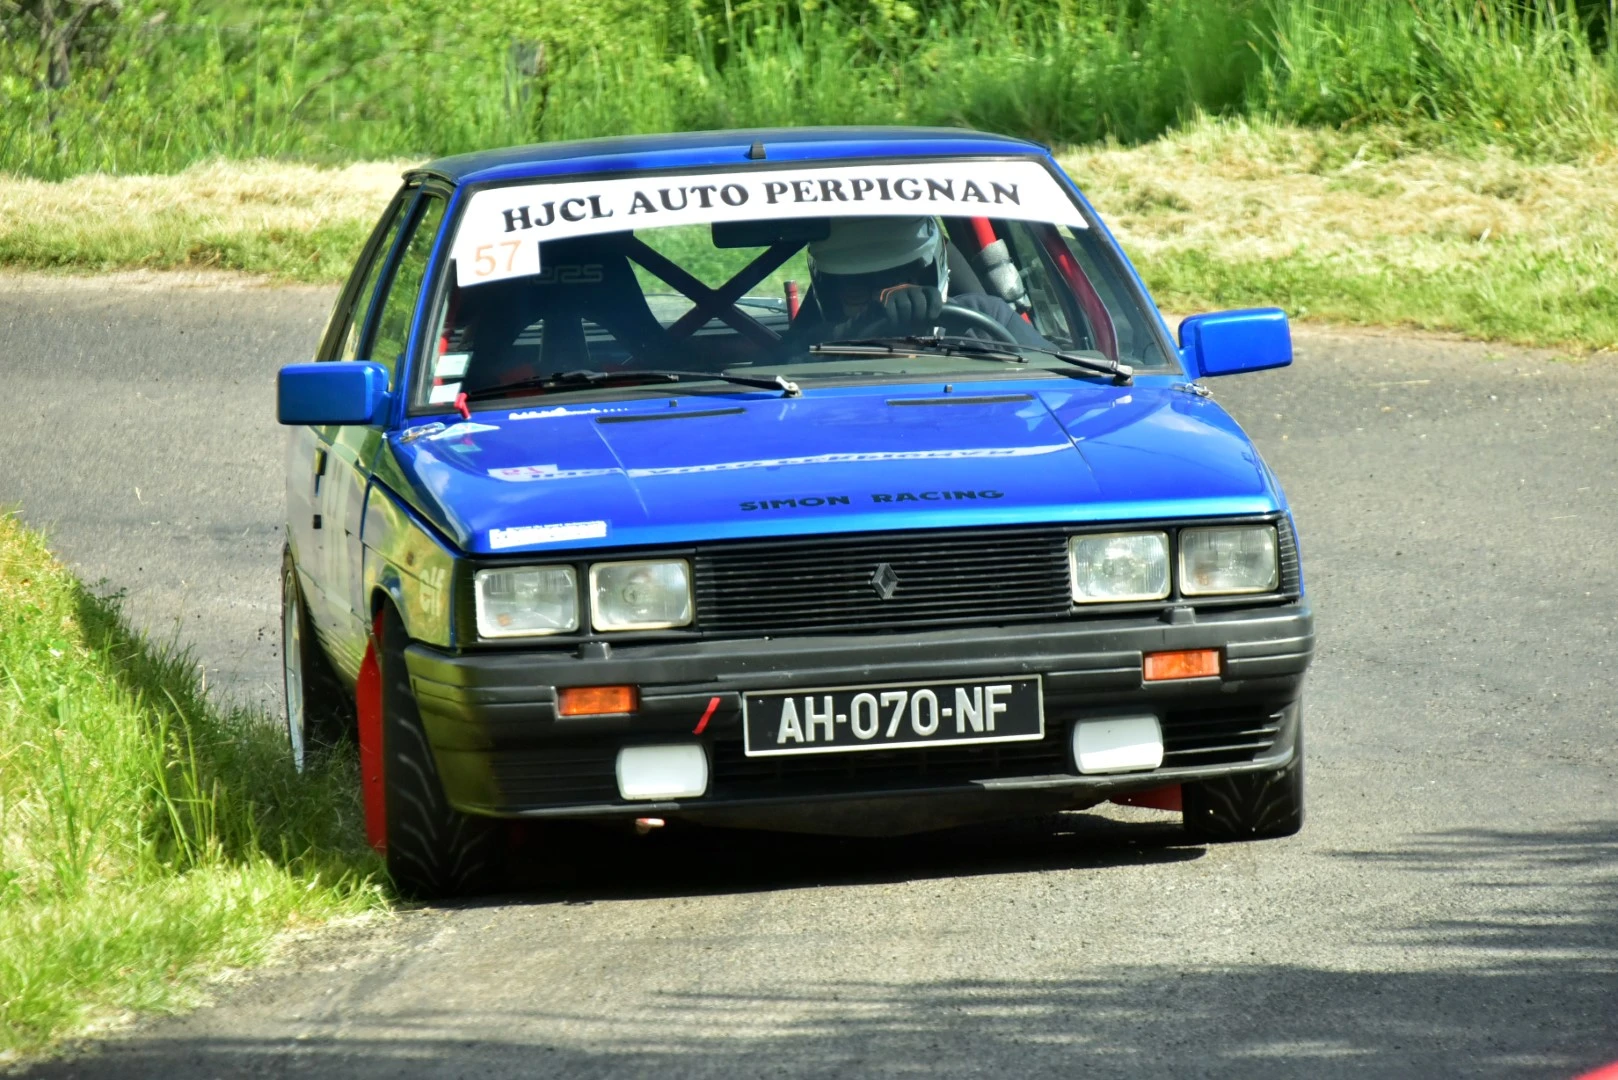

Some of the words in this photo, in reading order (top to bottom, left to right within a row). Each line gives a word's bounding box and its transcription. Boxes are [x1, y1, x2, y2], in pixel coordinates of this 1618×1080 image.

[502, 195, 613, 232] HJCL
[628, 183, 749, 215] AUTO
[762, 178, 1021, 206] PERPIGNAN
[475, 240, 522, 276] 57
[739, 495, 850, 511] SIMON
[871, 489, 1005, 503] RACING
[777, 685, 1012, 744] AH-070-NF
